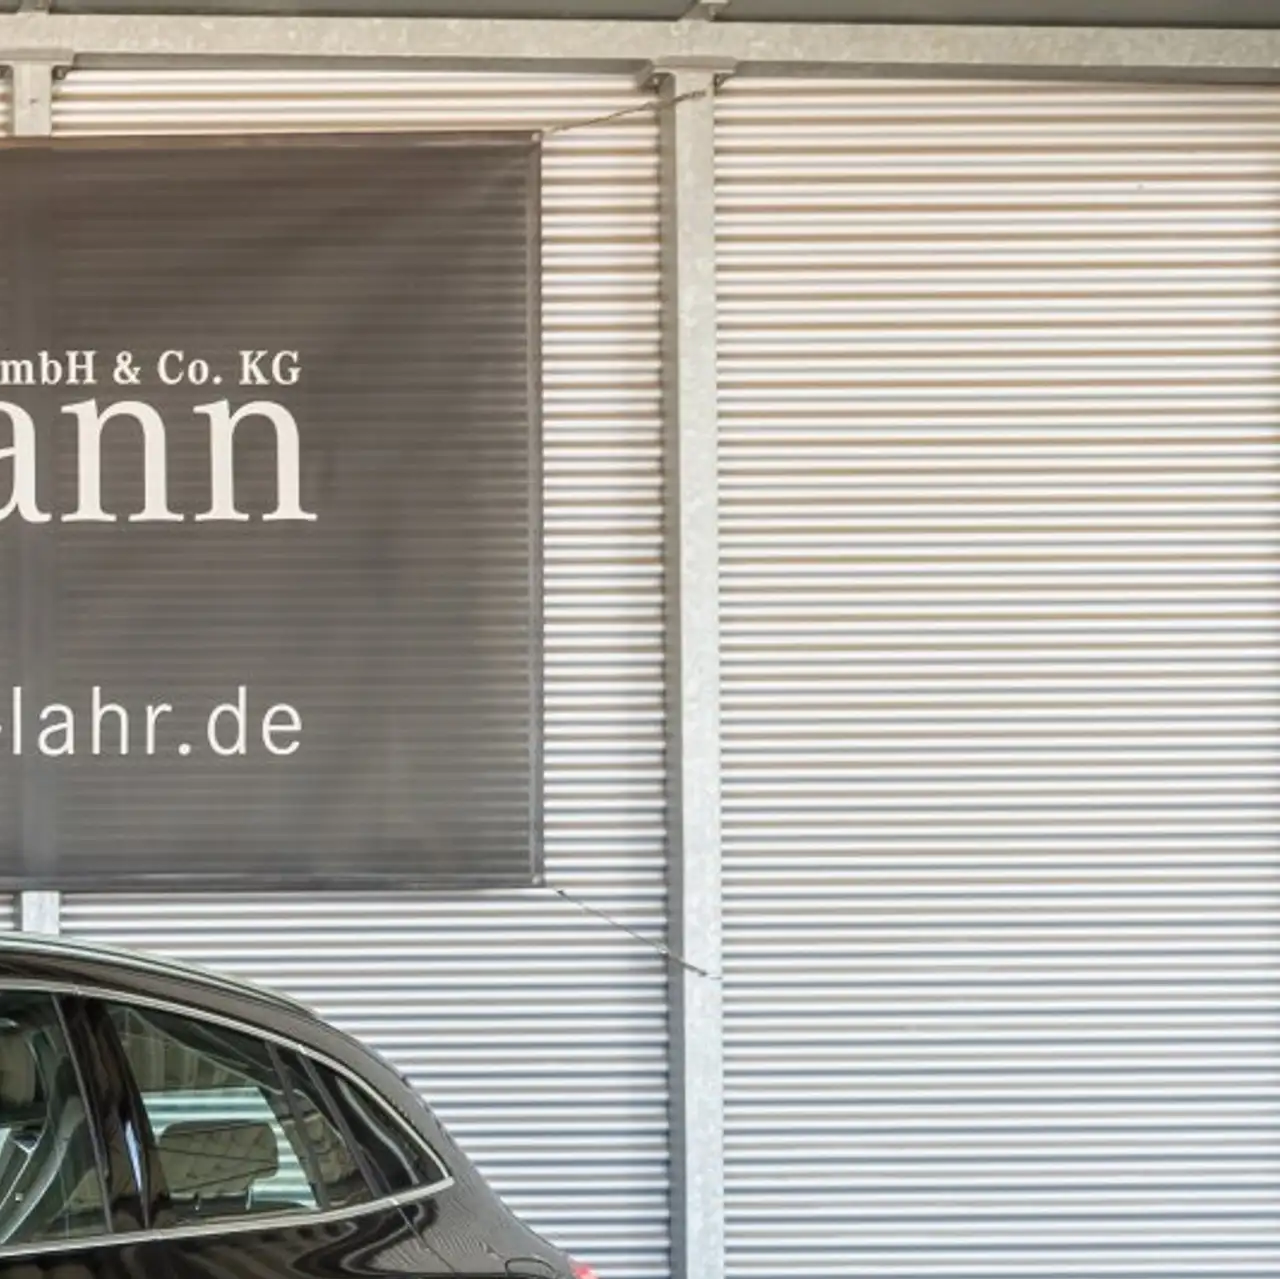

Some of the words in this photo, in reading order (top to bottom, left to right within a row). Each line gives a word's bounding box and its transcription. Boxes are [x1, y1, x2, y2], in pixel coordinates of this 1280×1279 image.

[112, 350, 142, 386] &
[156, 349, 223, 386] Co.
[238, 349, 303, 386] KG
